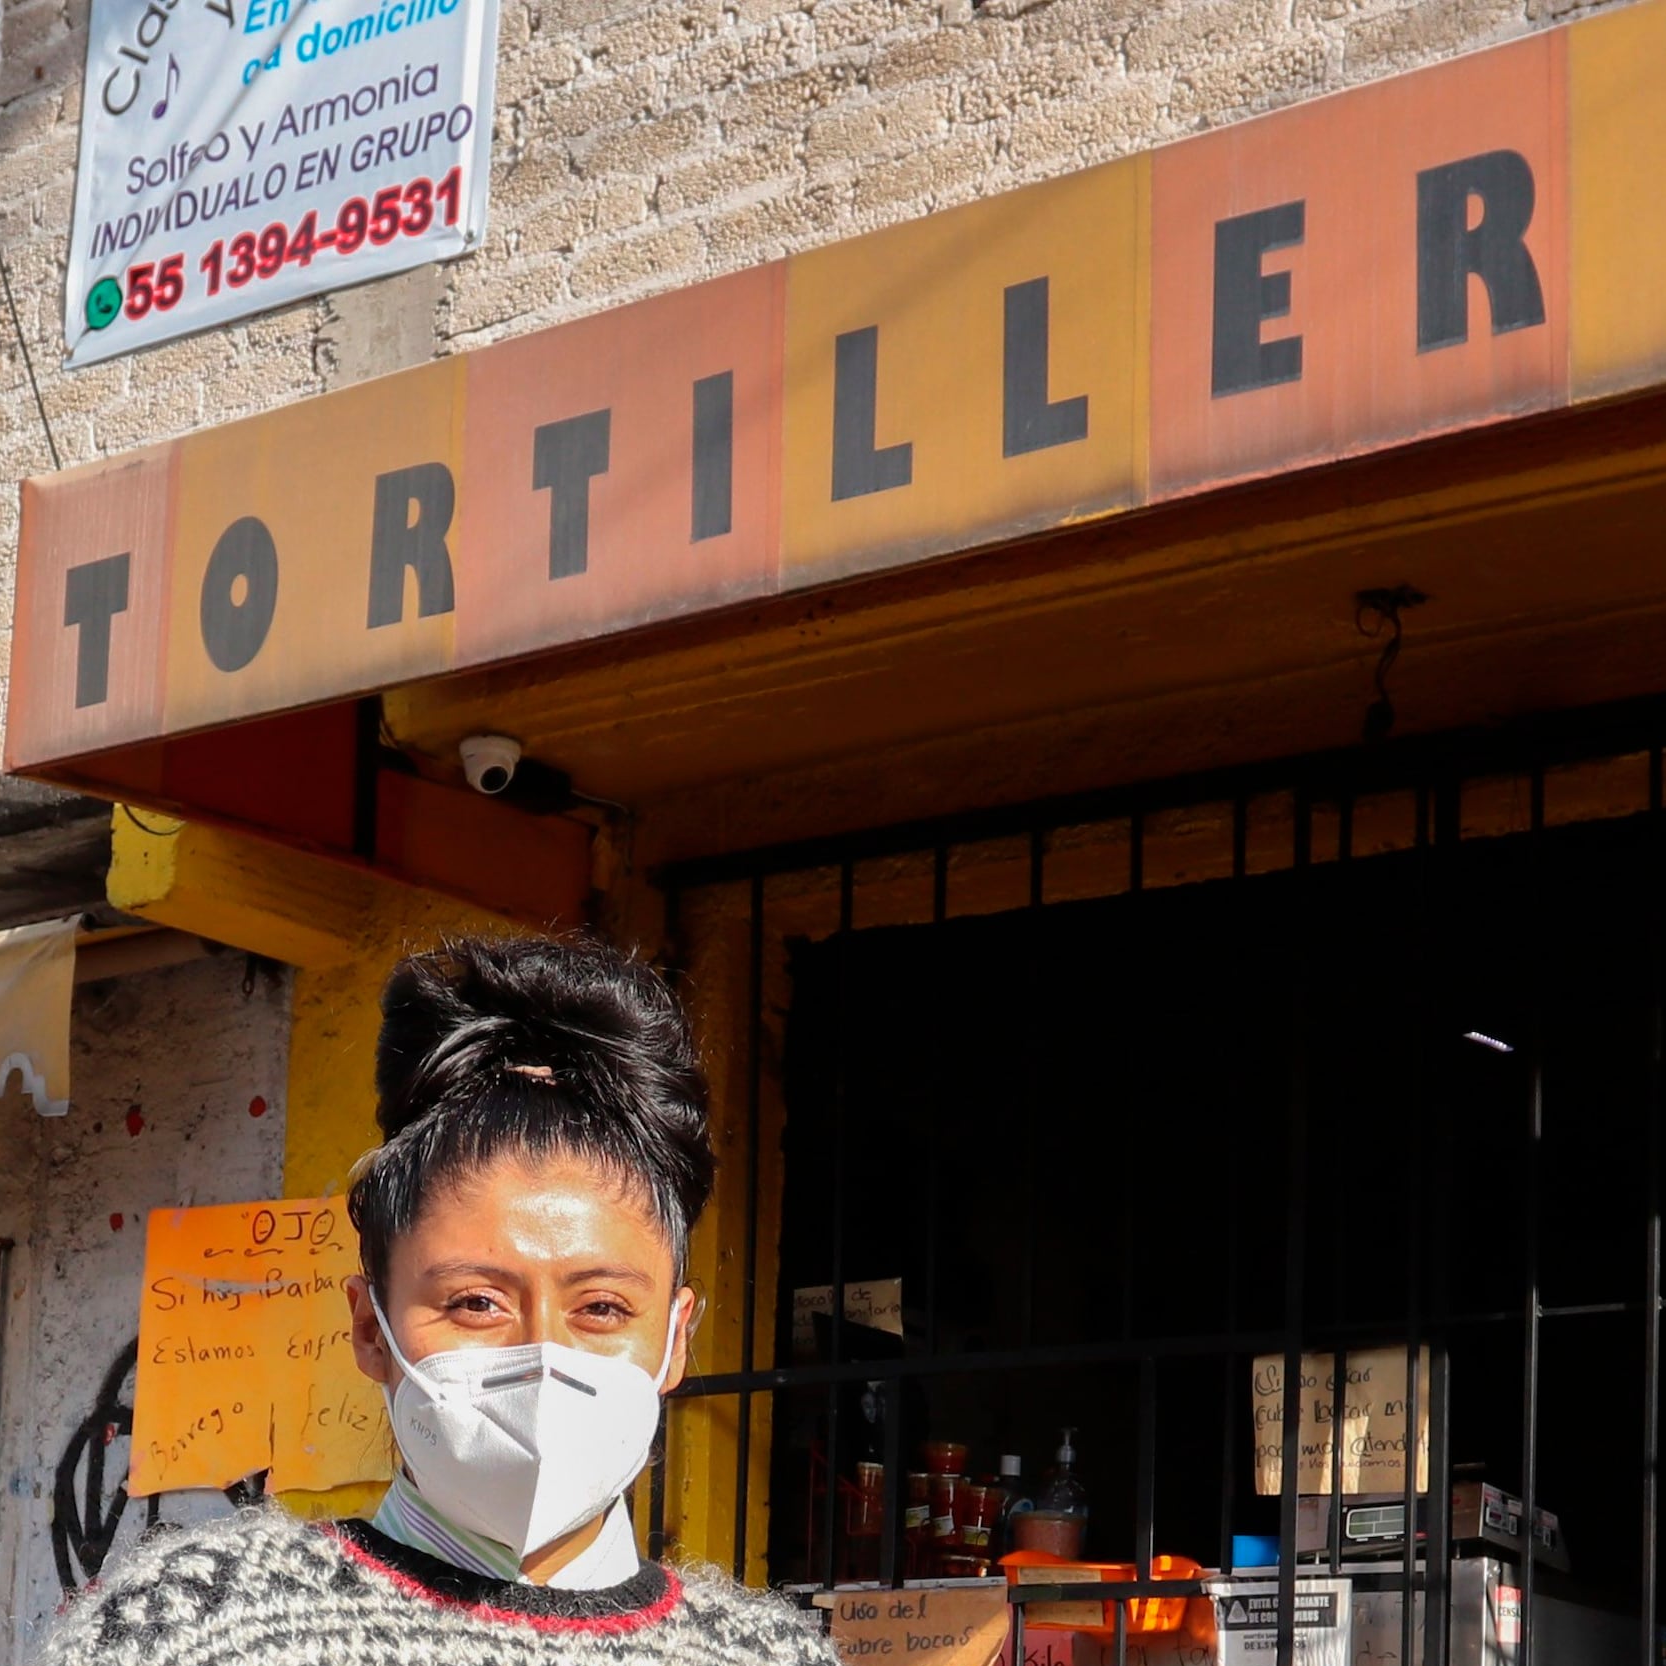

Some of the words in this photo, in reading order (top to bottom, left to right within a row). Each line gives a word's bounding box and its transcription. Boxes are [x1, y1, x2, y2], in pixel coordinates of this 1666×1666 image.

[239, 120, 265, 162] y
[271, 63, 440, 145] Armonia
[295, 144, 336, 192] EN
[350, 103, 474, 173] GRUPO
[123, 252, 186, 322] 55
[199, 165, 463, 297] 1394-9531
[152, 1336, 255, 1365] Estamos
[150, 1401, 244, 1480] Borrego
[840, 1600, 879, 1621] Uso
[887, 1594, 927, 1621] del
